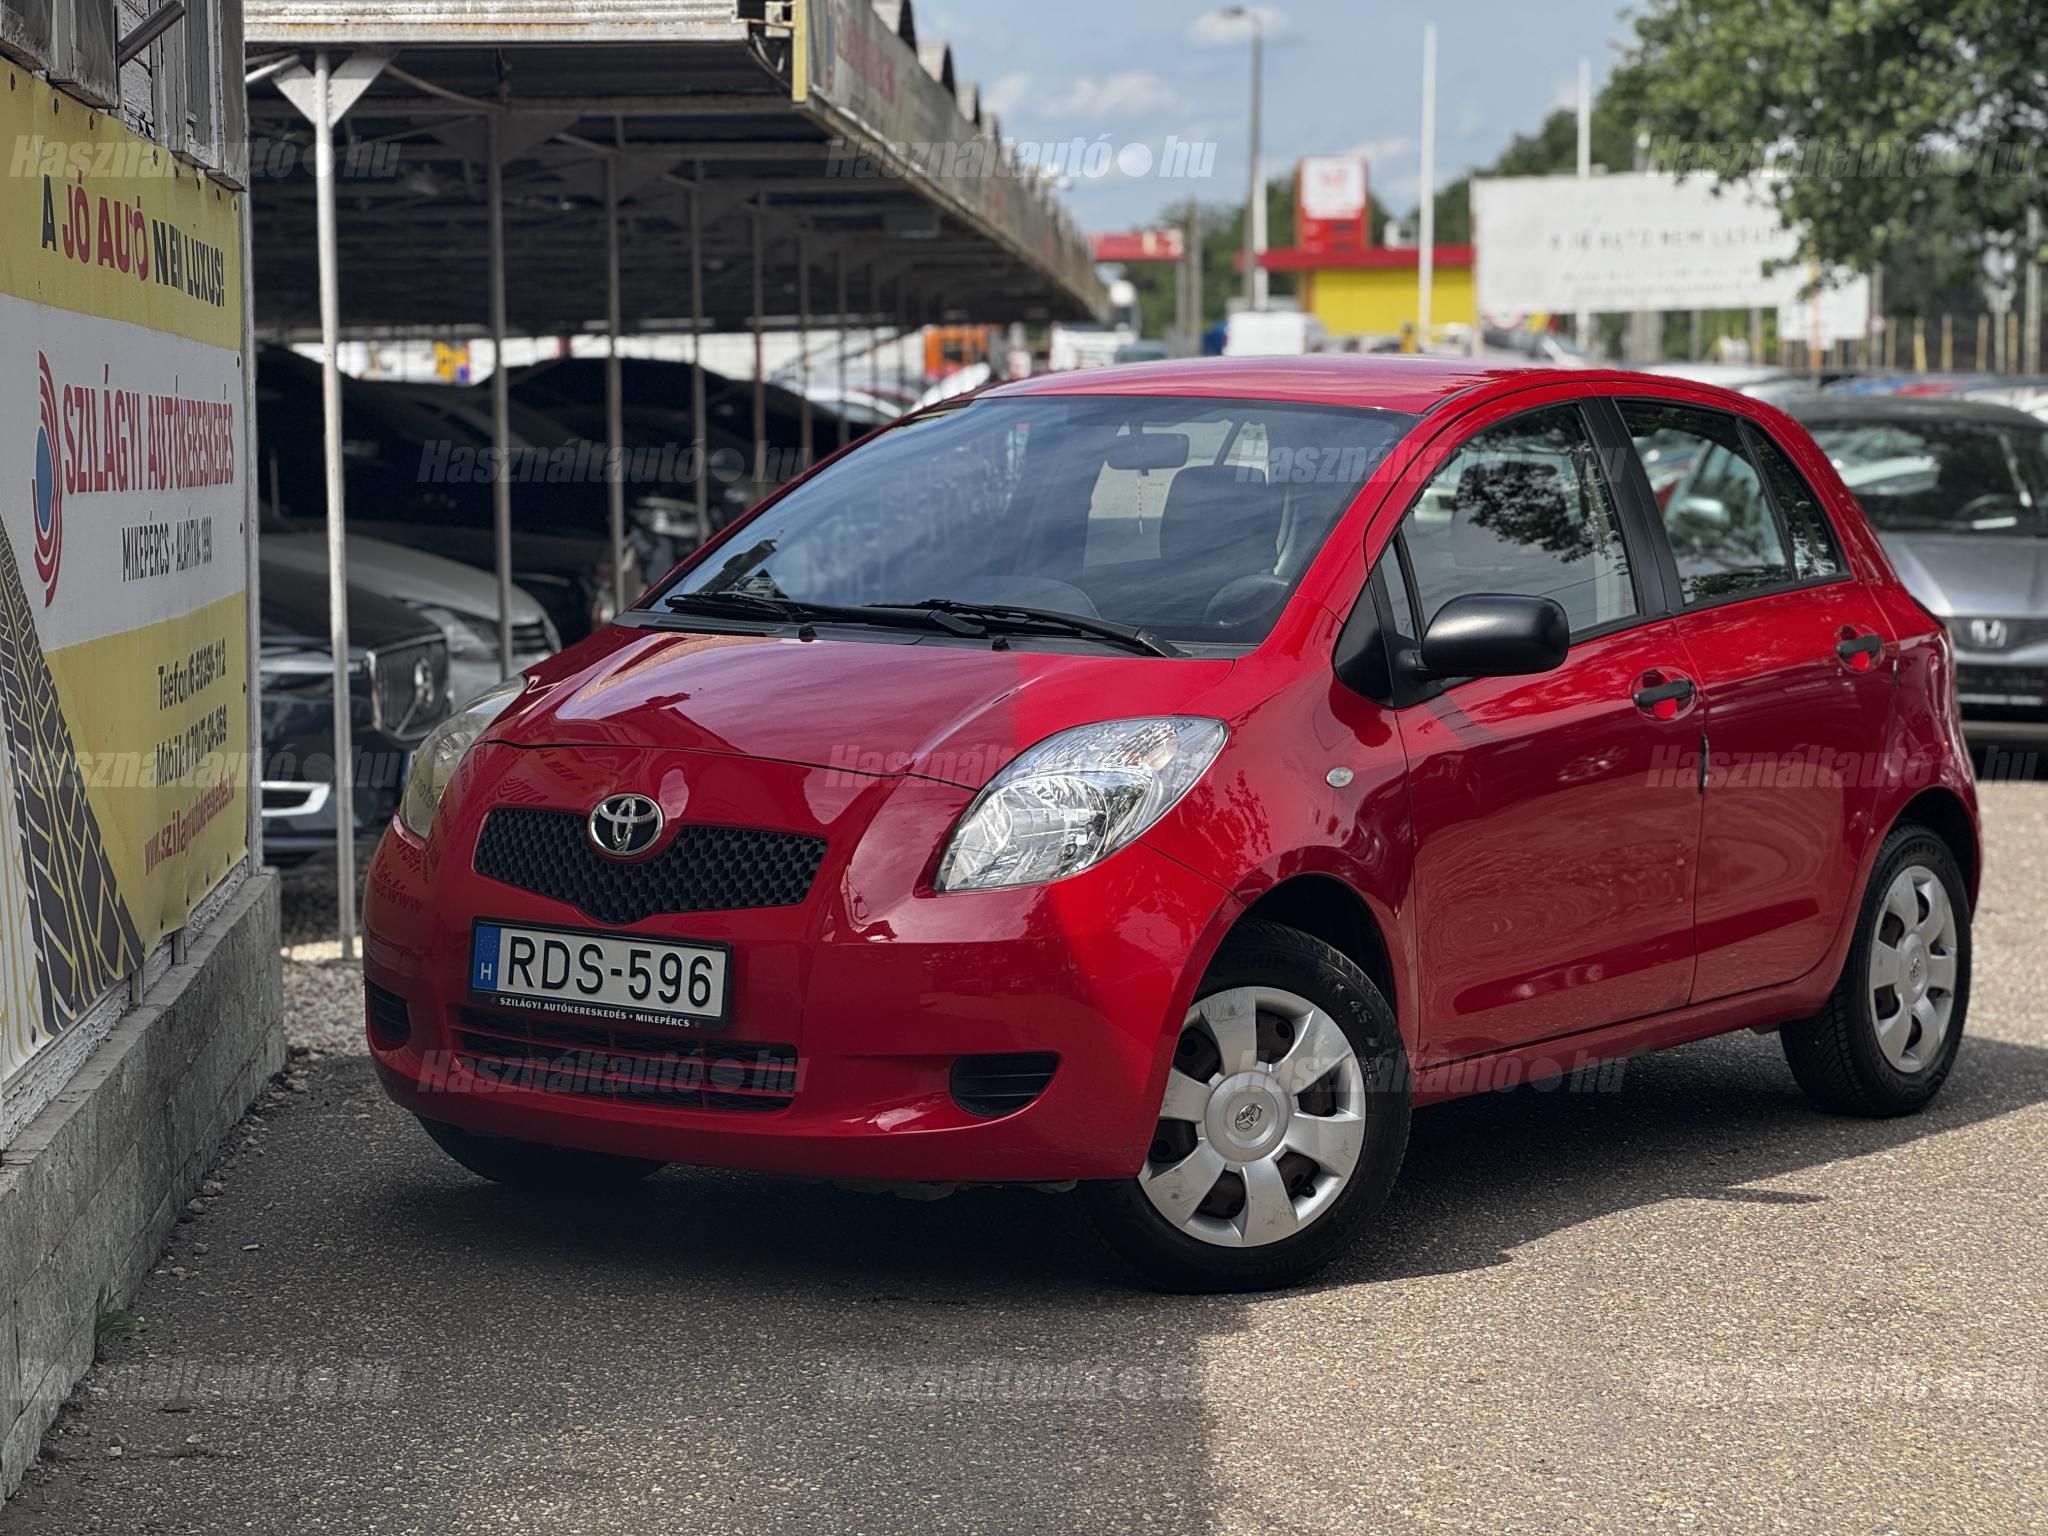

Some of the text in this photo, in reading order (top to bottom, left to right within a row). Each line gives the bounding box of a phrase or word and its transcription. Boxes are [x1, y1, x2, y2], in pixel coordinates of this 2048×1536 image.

[41, 169, 225, 308] A JÓ AUTÓ NEM LUXUS!
[63, 363, 235, 495] SZILÁGYI AUTÓKERESKEDÉS
[122, 510, 170, 582] MIKEPÉRCS
[480, 962, 492, 981] H
[507, 935, 713, 1007] RDS-596
[500, 996, 690, 1028] SZILÁGYI AUTÓKERESKEDÉS MIKEPÉRCS
